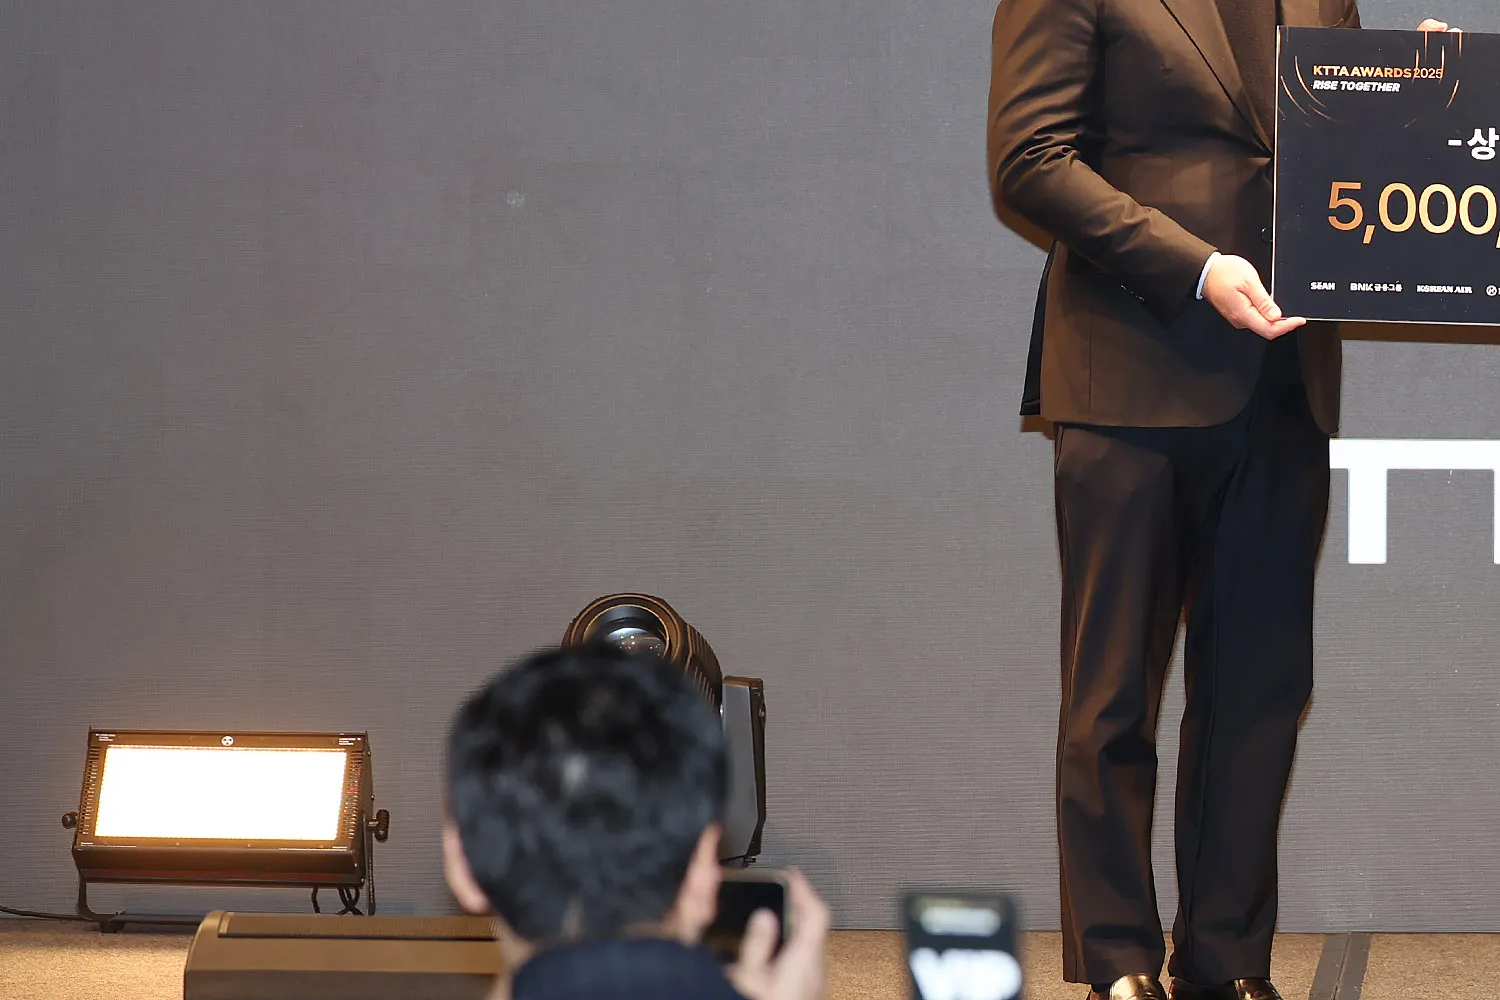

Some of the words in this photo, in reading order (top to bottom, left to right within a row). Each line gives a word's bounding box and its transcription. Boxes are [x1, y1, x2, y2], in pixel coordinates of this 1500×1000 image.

[1313, 65, 1349, 77] KTTA
[1350, 66, 1412, 79] AWARDS
[1413, 67, 1443, 79] 2025
[1312, 80, 1338, 91] RISE
[1341, 81, 1401, 93] TOGETHER
[1454, 285, 1473, 294] AIR
